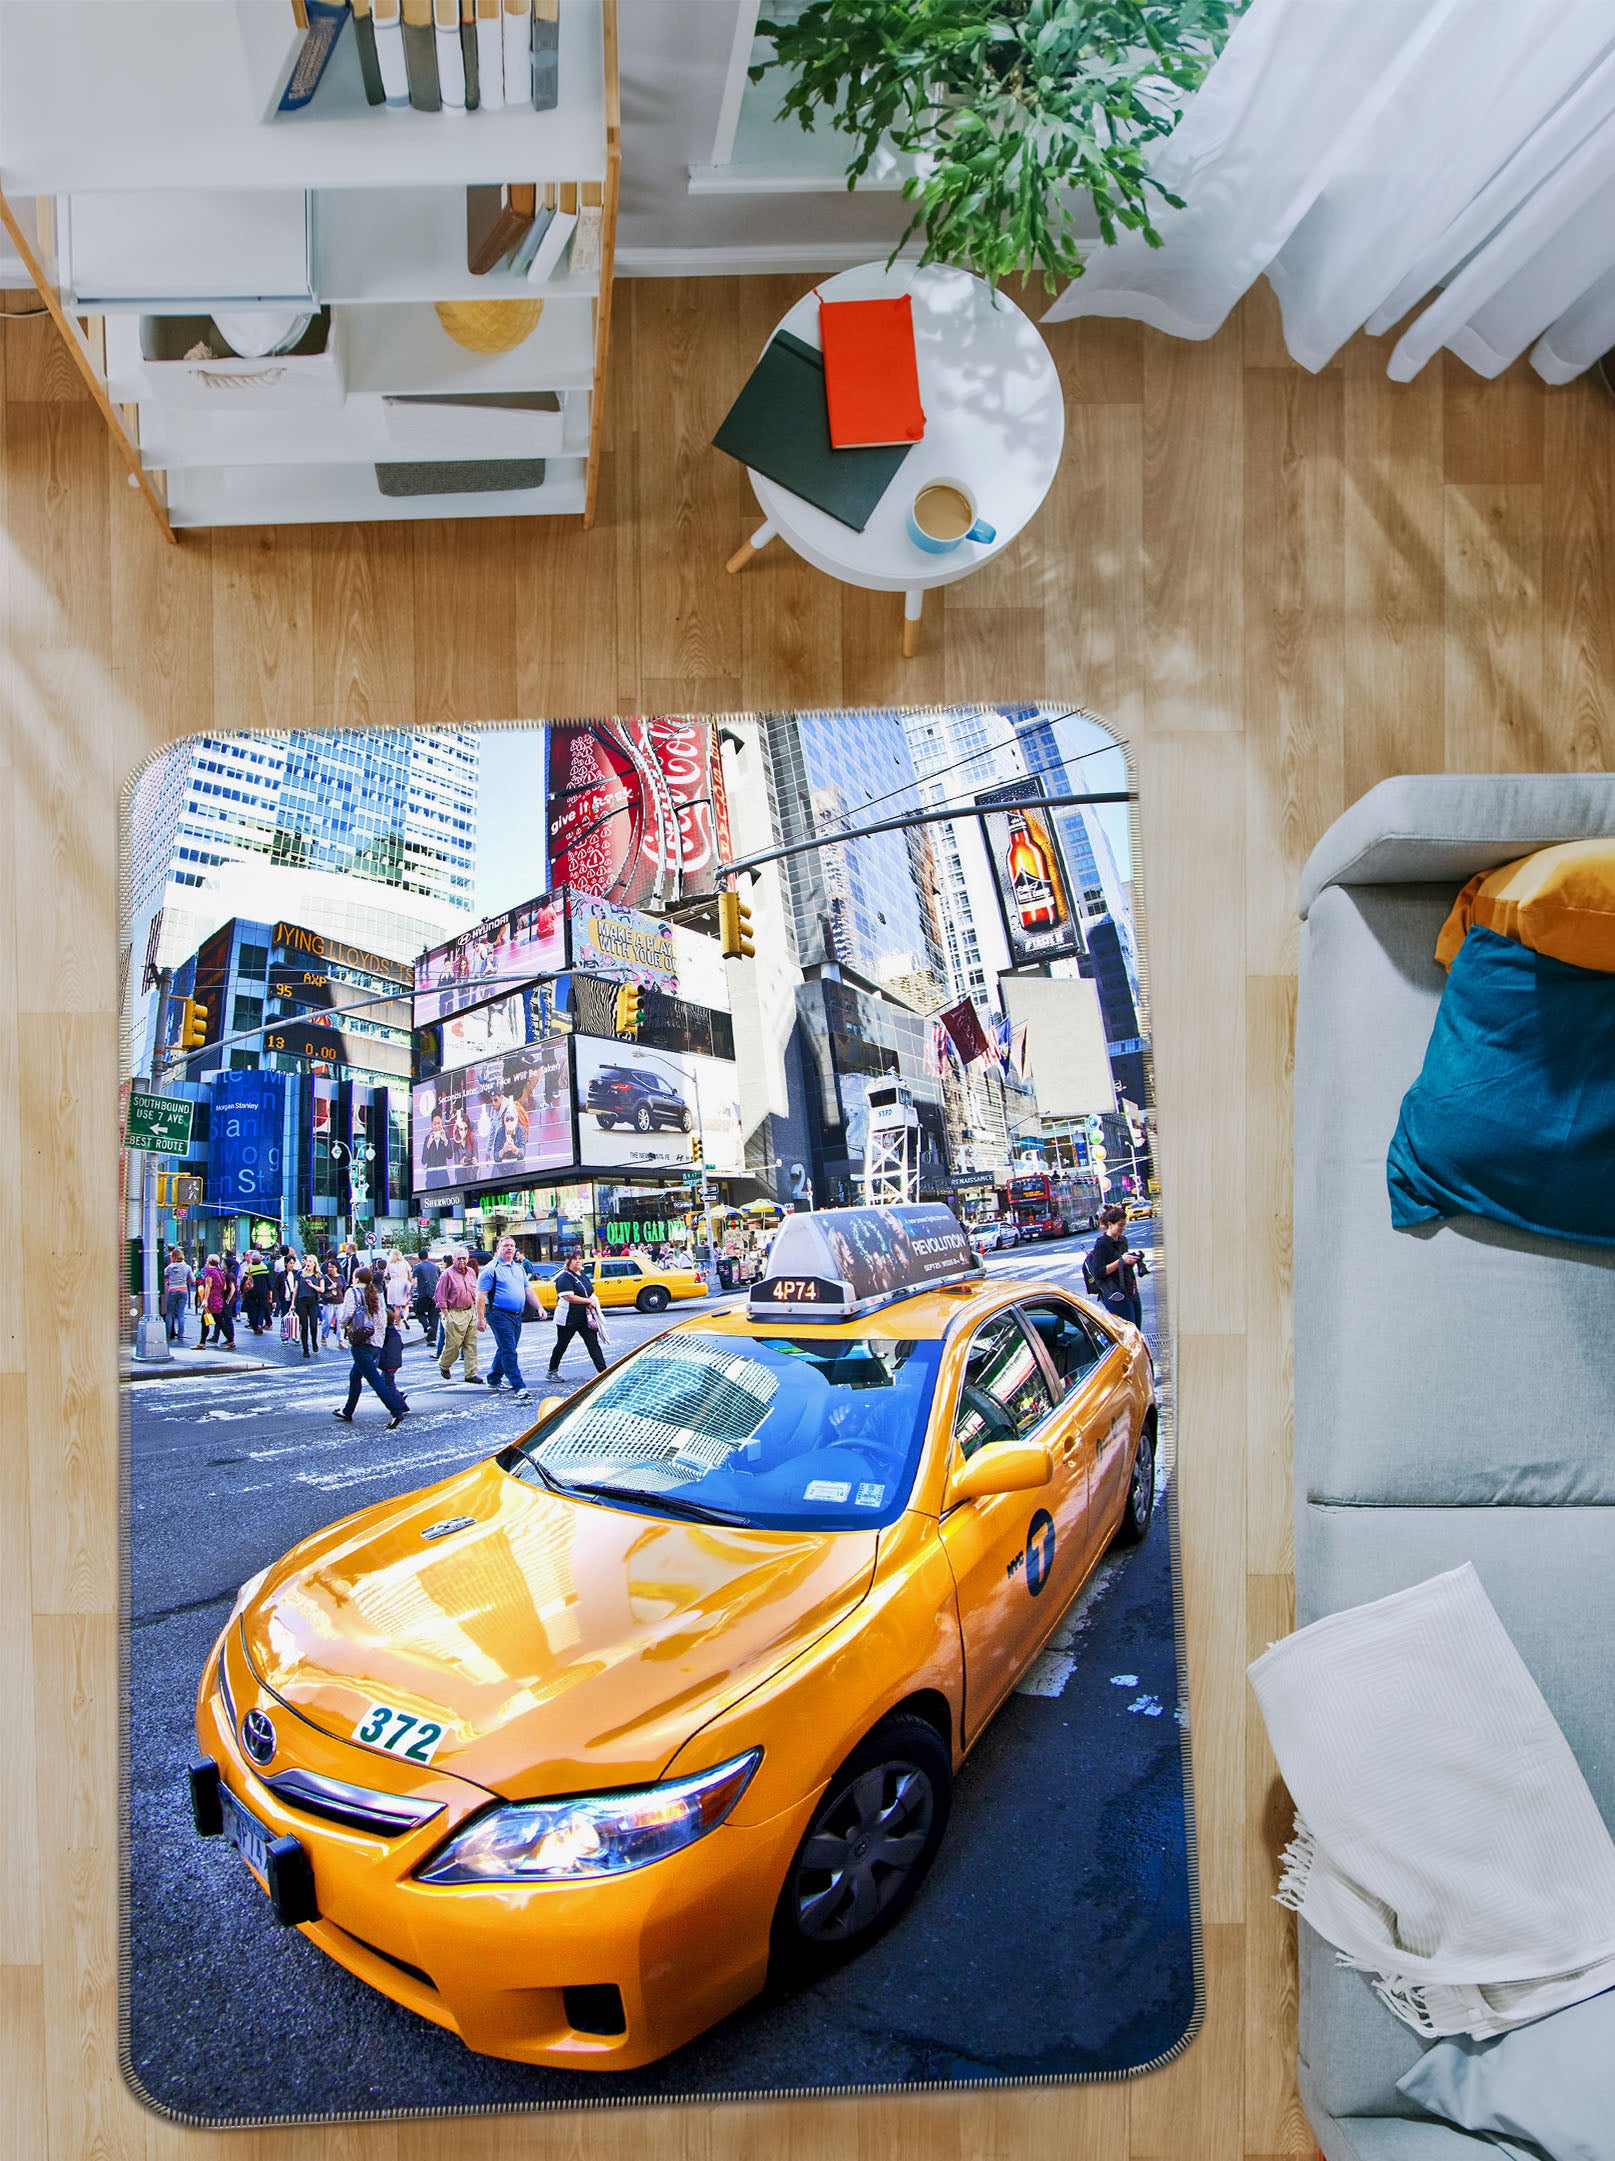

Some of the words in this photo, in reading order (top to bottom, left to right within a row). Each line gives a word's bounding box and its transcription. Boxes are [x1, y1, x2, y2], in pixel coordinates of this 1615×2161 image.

[550, 811, 576, 836] give
[579, 801, 588, 816] it
[472, 914, 509, 938] HYUNDAI
[597, 920, 632, 944] MAKE
[635, 933, 645, 947] A
[599, 936, 631, 958] WITH
[633, 946, 663, 970] YOUR
[303, 972, 328, 988] AXP
[305, 1043, 337, 1060] 0.00
[480, 1080, 494, 1093] Your
[513, 1072, 528, 1083] Will
[540, 1062, 561, 1074] Taken
[133, 1096, 190, 1114] SOUTHBOUND
[216, 1104, 235, 1112] Morgan
[235, 1101, 259, 1112] Stanley
[136, 1108, 154, 1121] USE
[158, 1111, 164, 1122] 7
[167, 1113, 184, 1125] AVE
[129, 1135, 151, 1148] BEST
[155, 1138, 184, 1152] ROUTE
[790, 1163, 811, 1200] 2
[951, 1173, 994, 1186] RENAISSANCE
[424, 1195, 460, 1209] SHERWOOD
[772, 1280, 818, 1301] 4P74
[359, 1707, 442, 1762] 372
